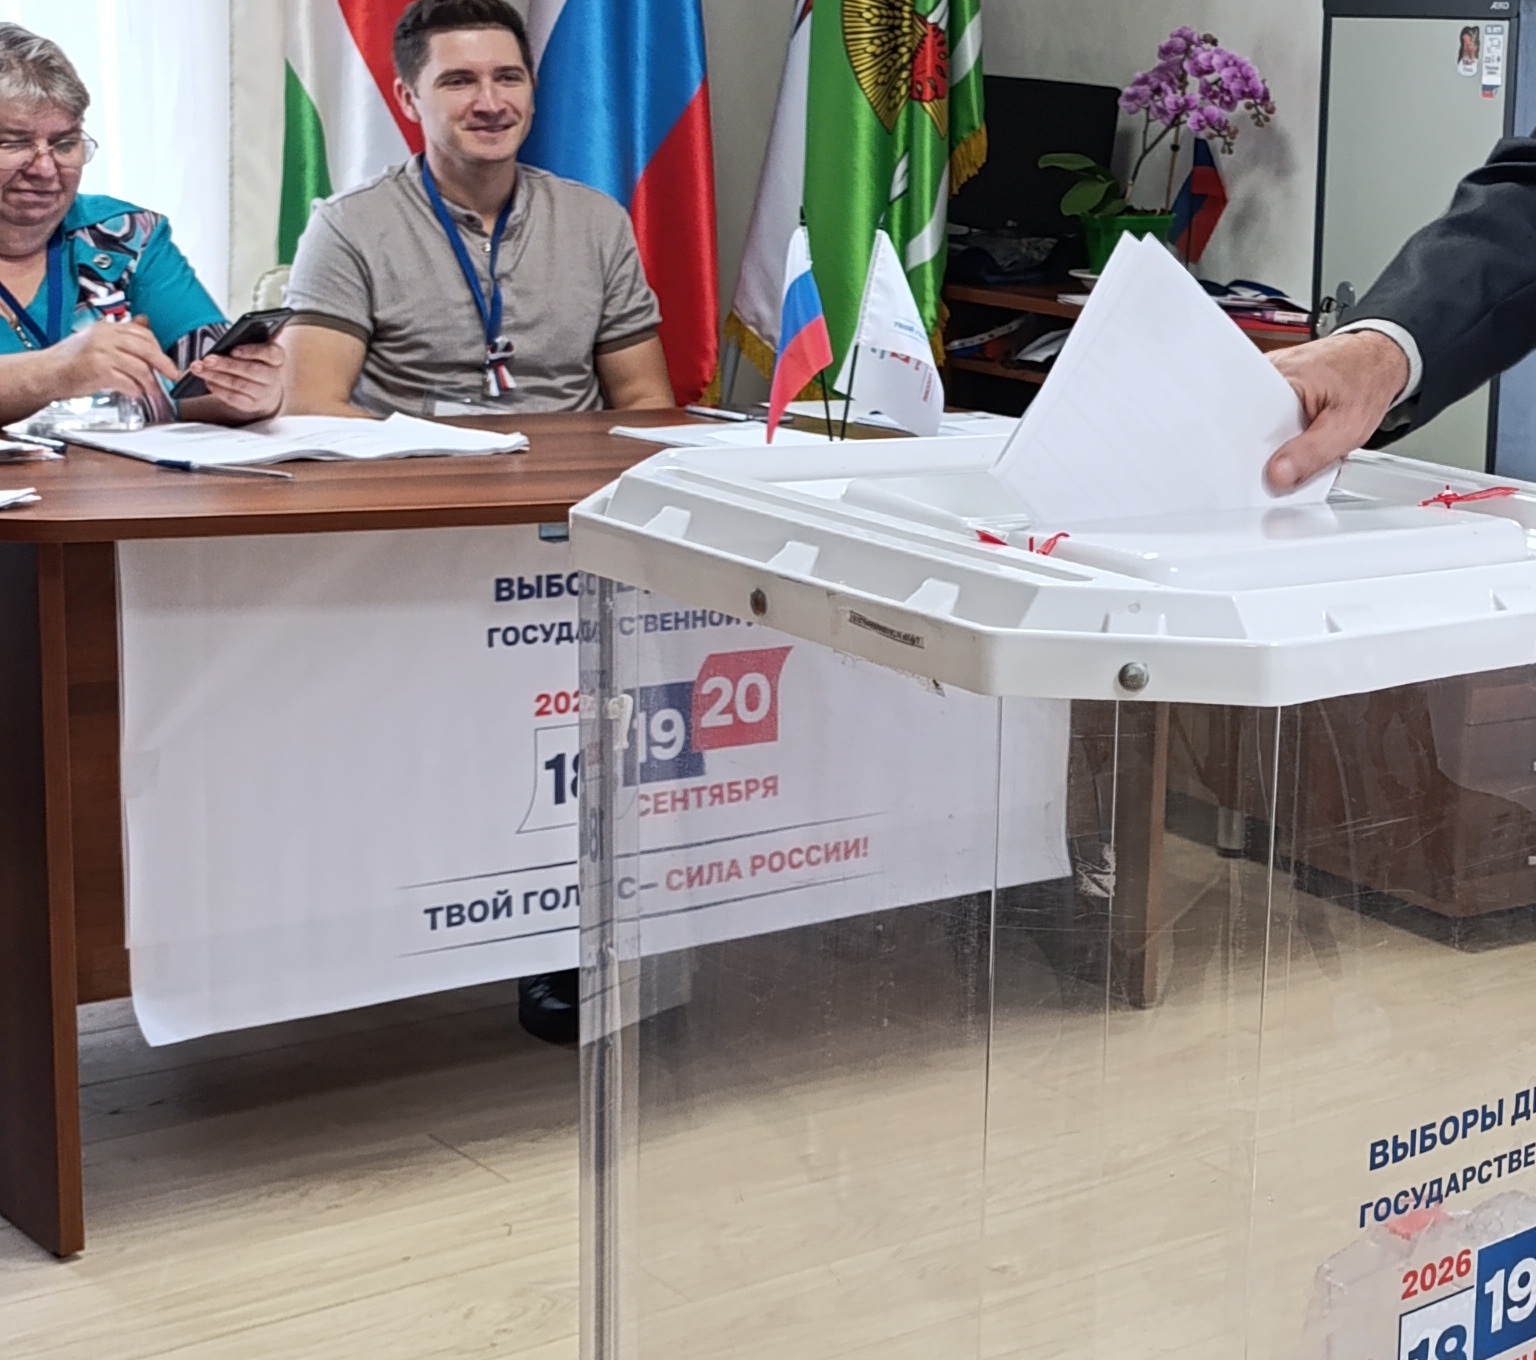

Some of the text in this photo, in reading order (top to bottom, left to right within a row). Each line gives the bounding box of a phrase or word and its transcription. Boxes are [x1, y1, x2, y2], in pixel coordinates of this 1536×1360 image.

[634, 707, 687, 761] 19
[700, 672, 772, 728] 20
[638, 775, 779, 817] СЕНТЯБРЯ
[424, 890, 513, 931] ТВОЙ
[523, 876, 636, 915] ГОЛС
[666, 854, 743, 893] СИЛА
[750, 836, 870, 878] РОССИИ!
[1369, 1098, 1504, 1171] ВЫБОРЫ
[1401, 1249, 1472, 1300] 2026
